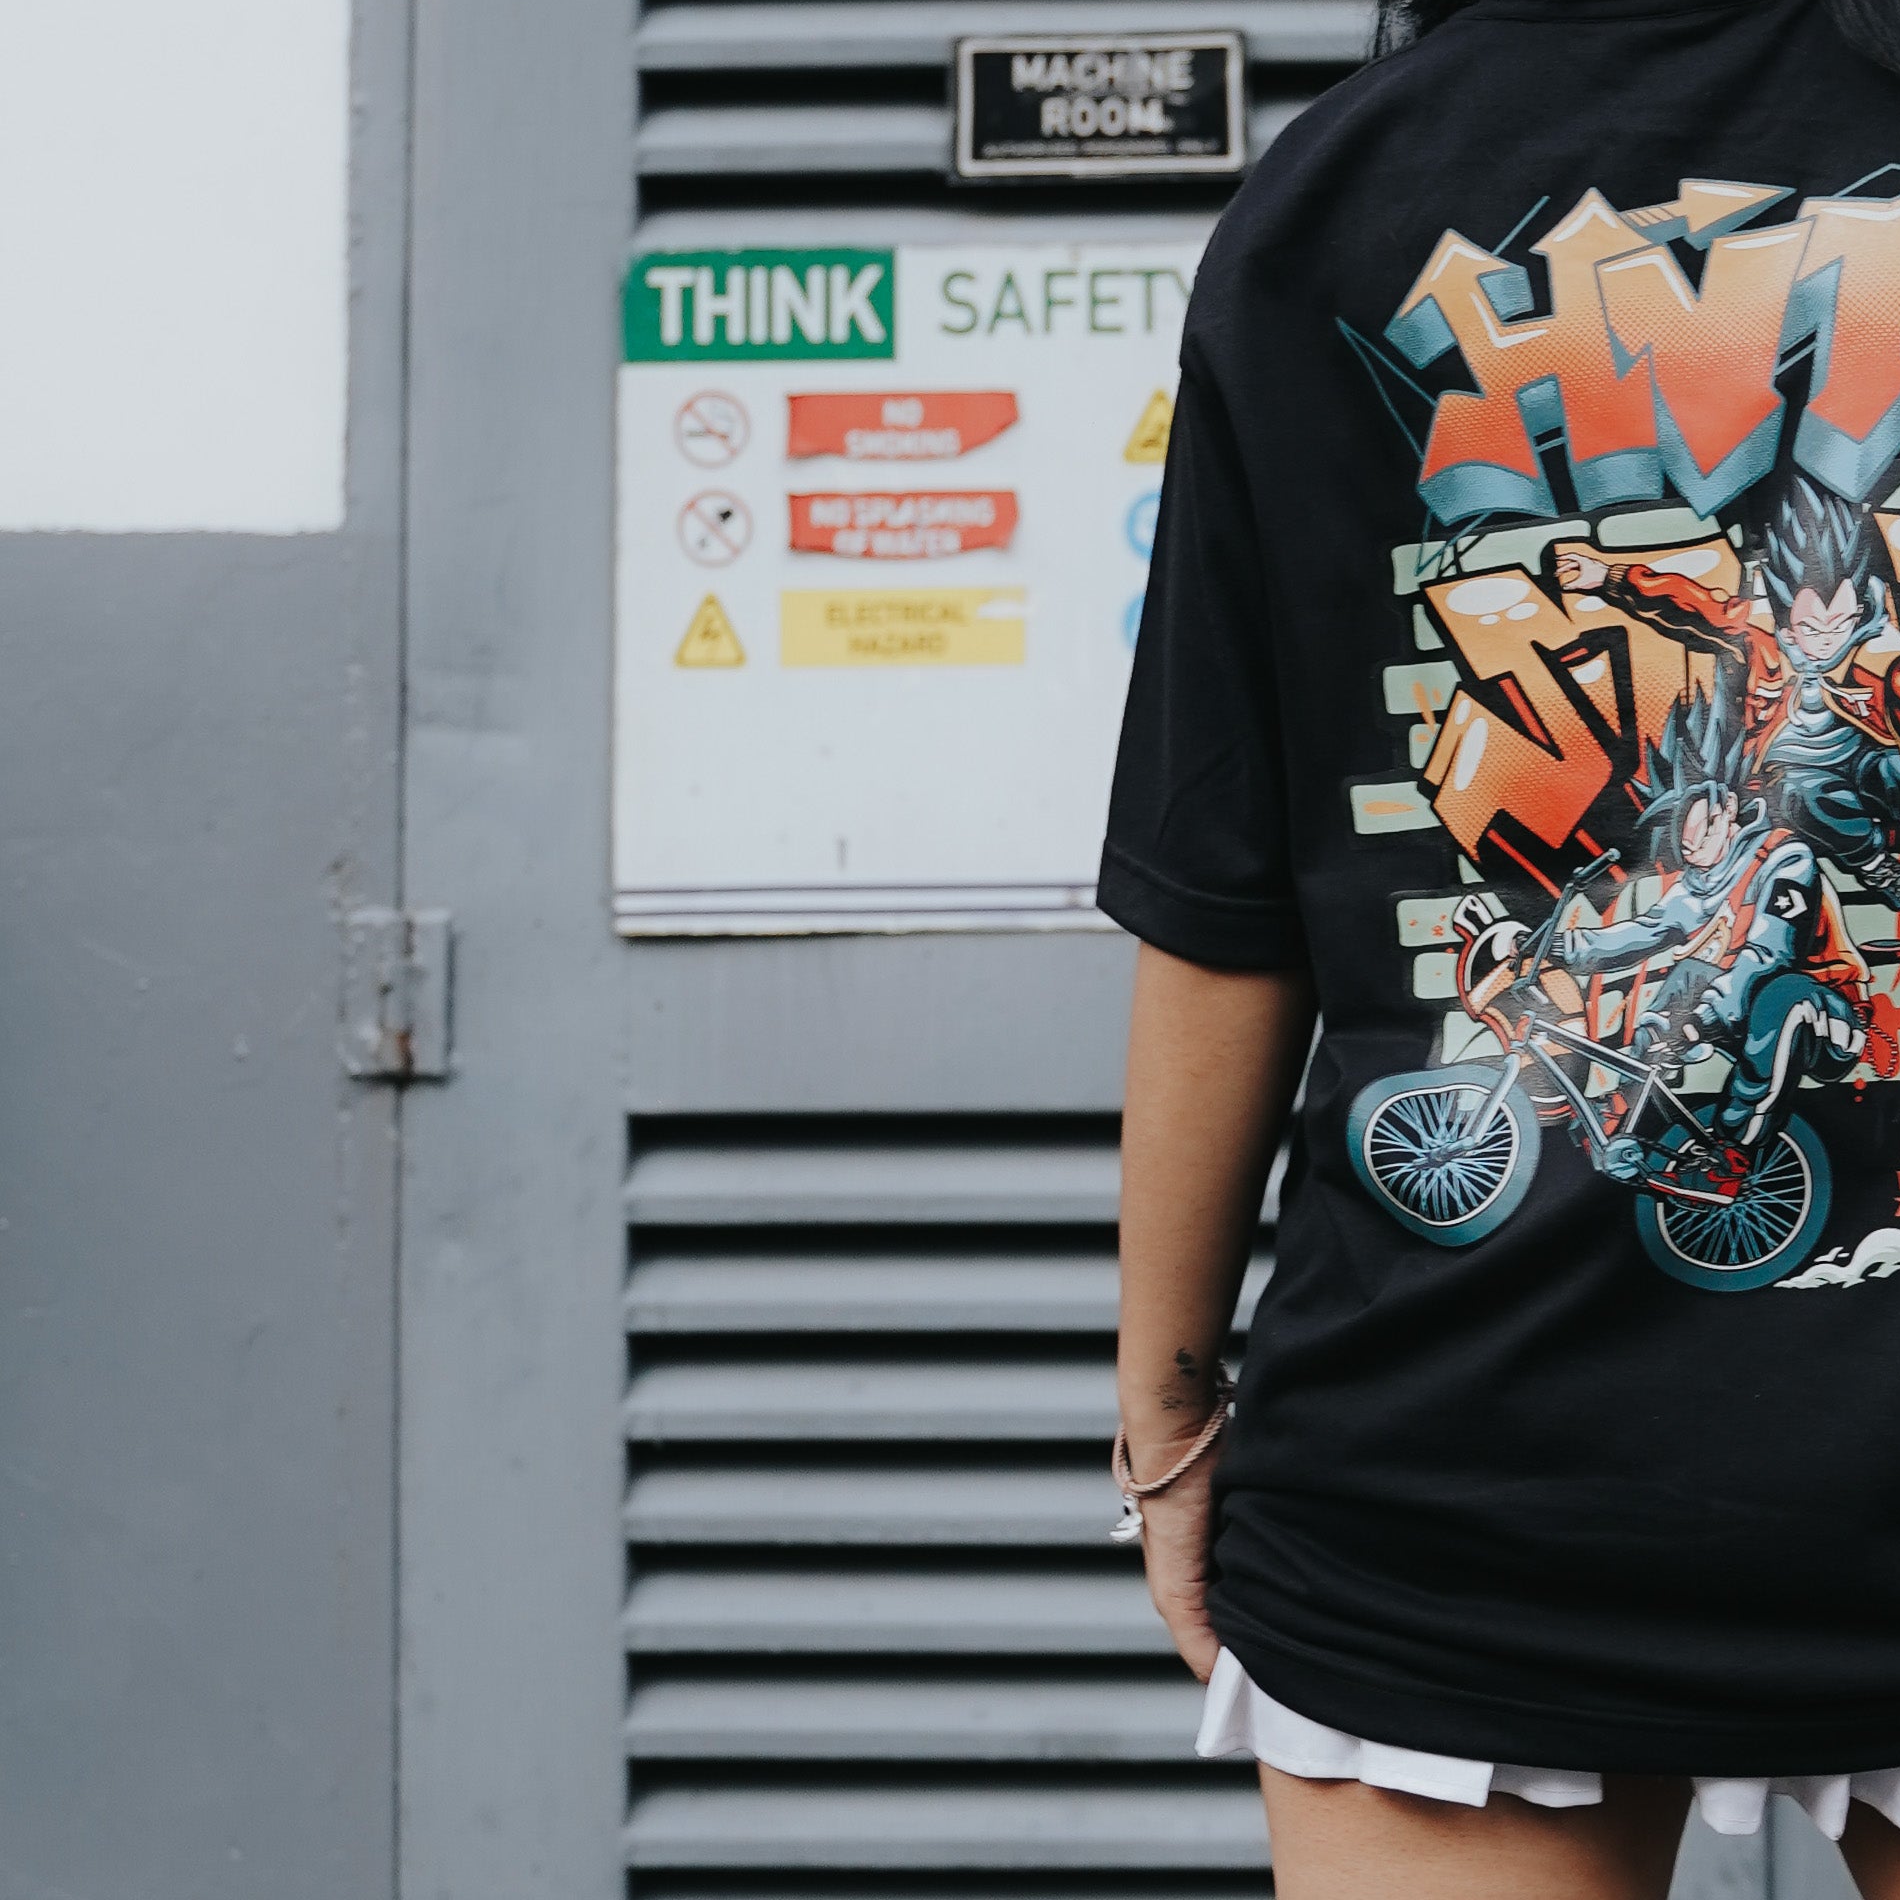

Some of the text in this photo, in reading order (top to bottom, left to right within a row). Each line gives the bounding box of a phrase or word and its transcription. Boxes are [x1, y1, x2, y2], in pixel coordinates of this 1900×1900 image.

[644, 263, 888, 346] THINK
[880, 398, 924, 428] NO
[809, 498, 850, 527] NO
